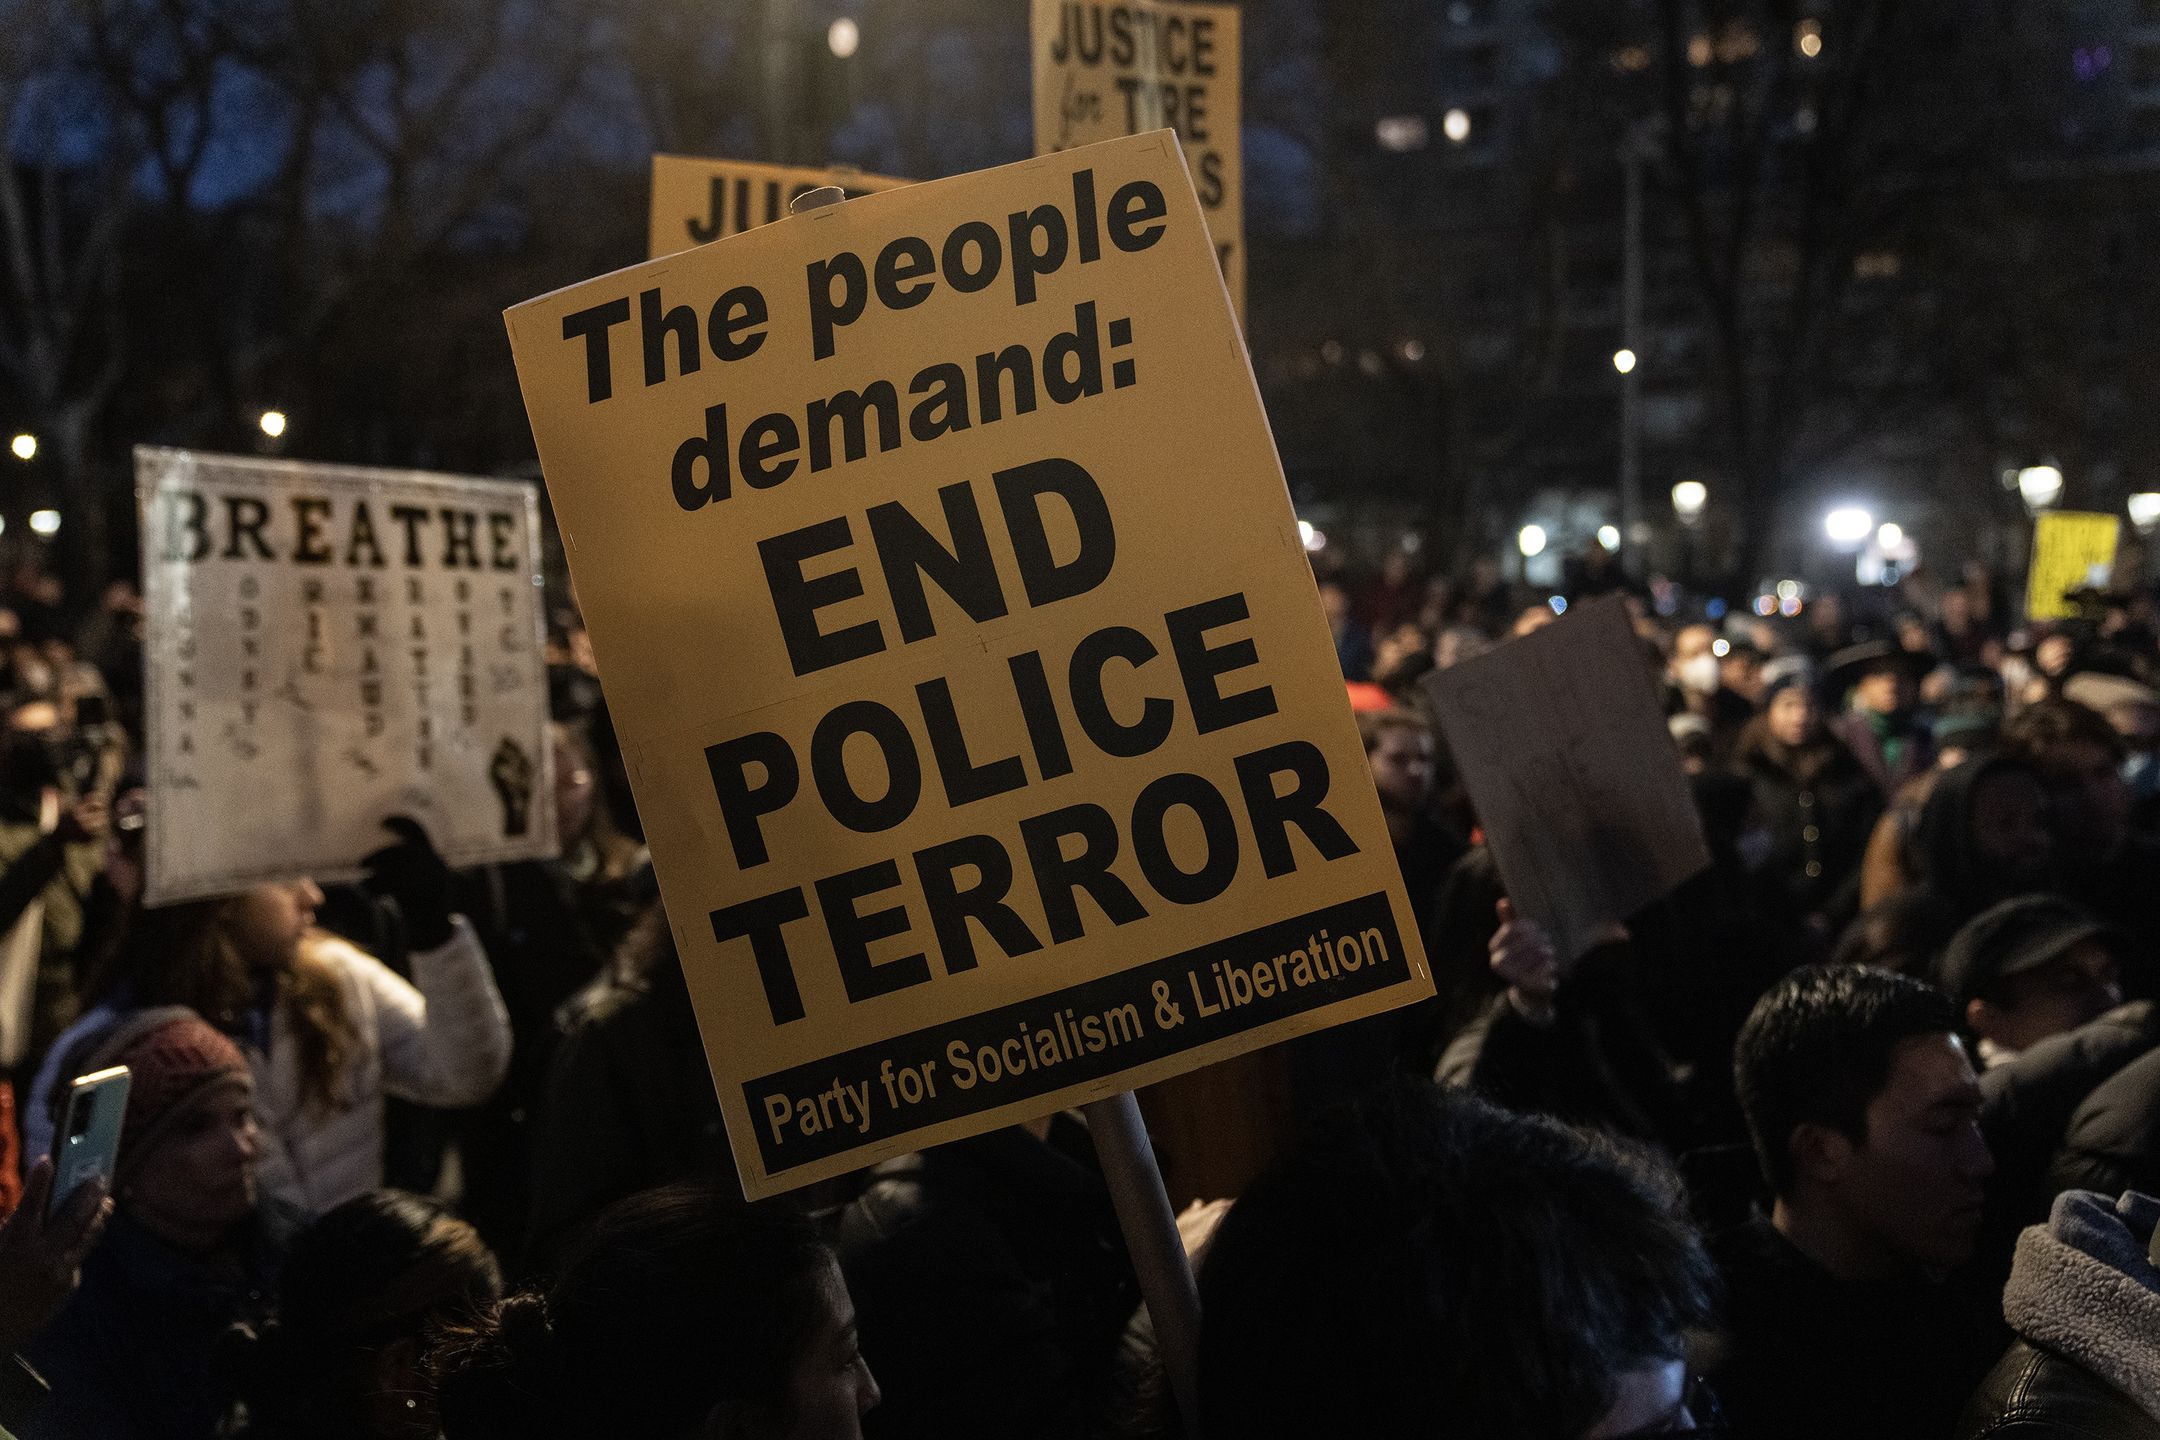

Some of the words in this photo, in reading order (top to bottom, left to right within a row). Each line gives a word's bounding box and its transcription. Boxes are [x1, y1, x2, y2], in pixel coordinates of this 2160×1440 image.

[1115, 76, 1208, 143] TRE
[562, 287, 768, 404] The
[807, 168, 1168, 361] people
[671, 301, 1137, 512] demand:
[160, 488, 518, 572] BREATHE
[757, 458, 1117, 678] END
[703, 592, 1280, 872] POLICE
[708, 740, 1361, 1028] TERROR
[763, 1076, 870, 1146] Party
[880, 1058, 937, 1109] for
[946, 1003, 1145, 1090] Socialism
[1151, 979, 1185, 1030] &
[1187, 926, 1390, 1019] Liberation
